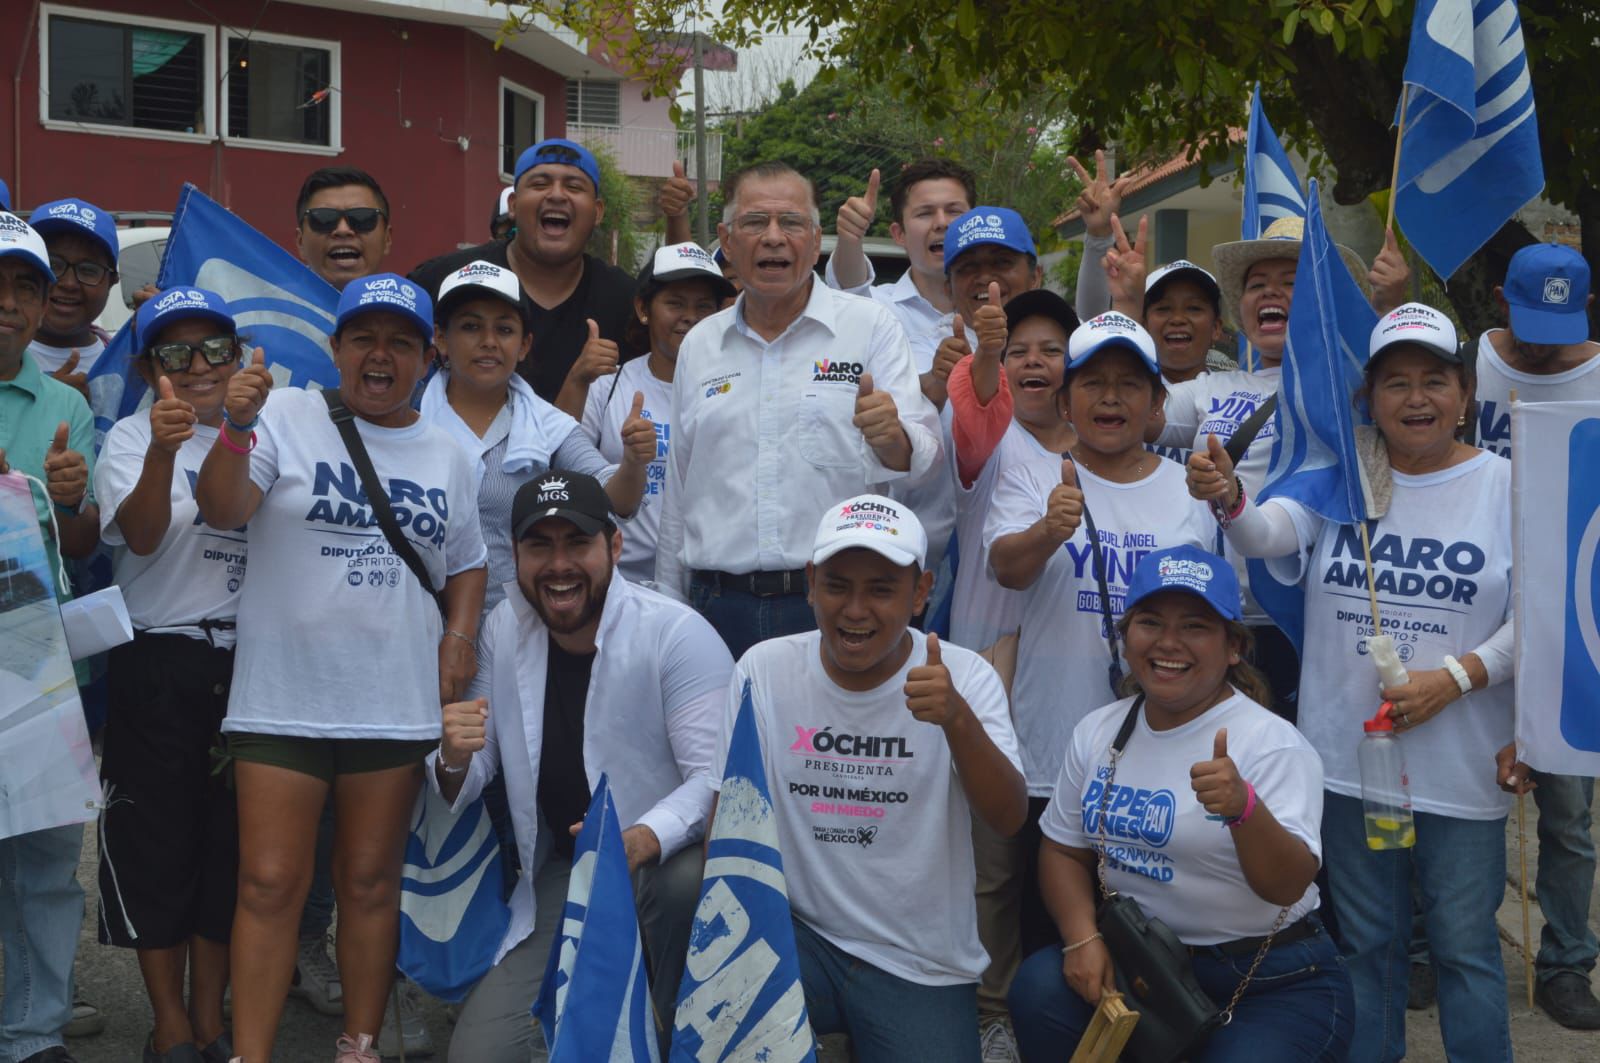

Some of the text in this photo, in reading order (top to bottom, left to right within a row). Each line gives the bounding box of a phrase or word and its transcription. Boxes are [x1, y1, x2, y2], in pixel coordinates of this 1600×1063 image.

[48, 204, 78, 215] VOTA
[0, 215, 28, 230] ARO
[0, 223, 29, 235] ADOR
[958, 215, 984, 233] VOTA
[968, 232, 1006, 241] VERDAD
[457, 270, 501, 280] AMADOR
[364, 278, 398, 291] VOTA
[154, 290, 186, 311] VOTA
[1090, 321, 1137, 331] AMADOR
[813, 358, 864, 376] NARO
[1208, 396, 1256, 422] YUN
[536, 489, 569, 504] MGS
[840, 501, 900, 520] XÓCHITL
[1122, 531, 1158, 548] ÁNGEL
[1158, 559, 1198, 571] PEPE
[1323, 560, 1479, 606] AMADOR
[1403, 620, 1448, 635] LOCAL
[1410, 633, 1419, 643] 5
[789, 724, 914, 759] XÓCHITL
[804, 758, 895, 777] PRESIDENTA
[789, 782, 910, 804] POR UN MÉXICO
[811, 801, 886, 819] SIN MIEDO
[1082, 779, 1171, 835] PEPE PAN
[1081, 803, 1142, 840] YUNES
